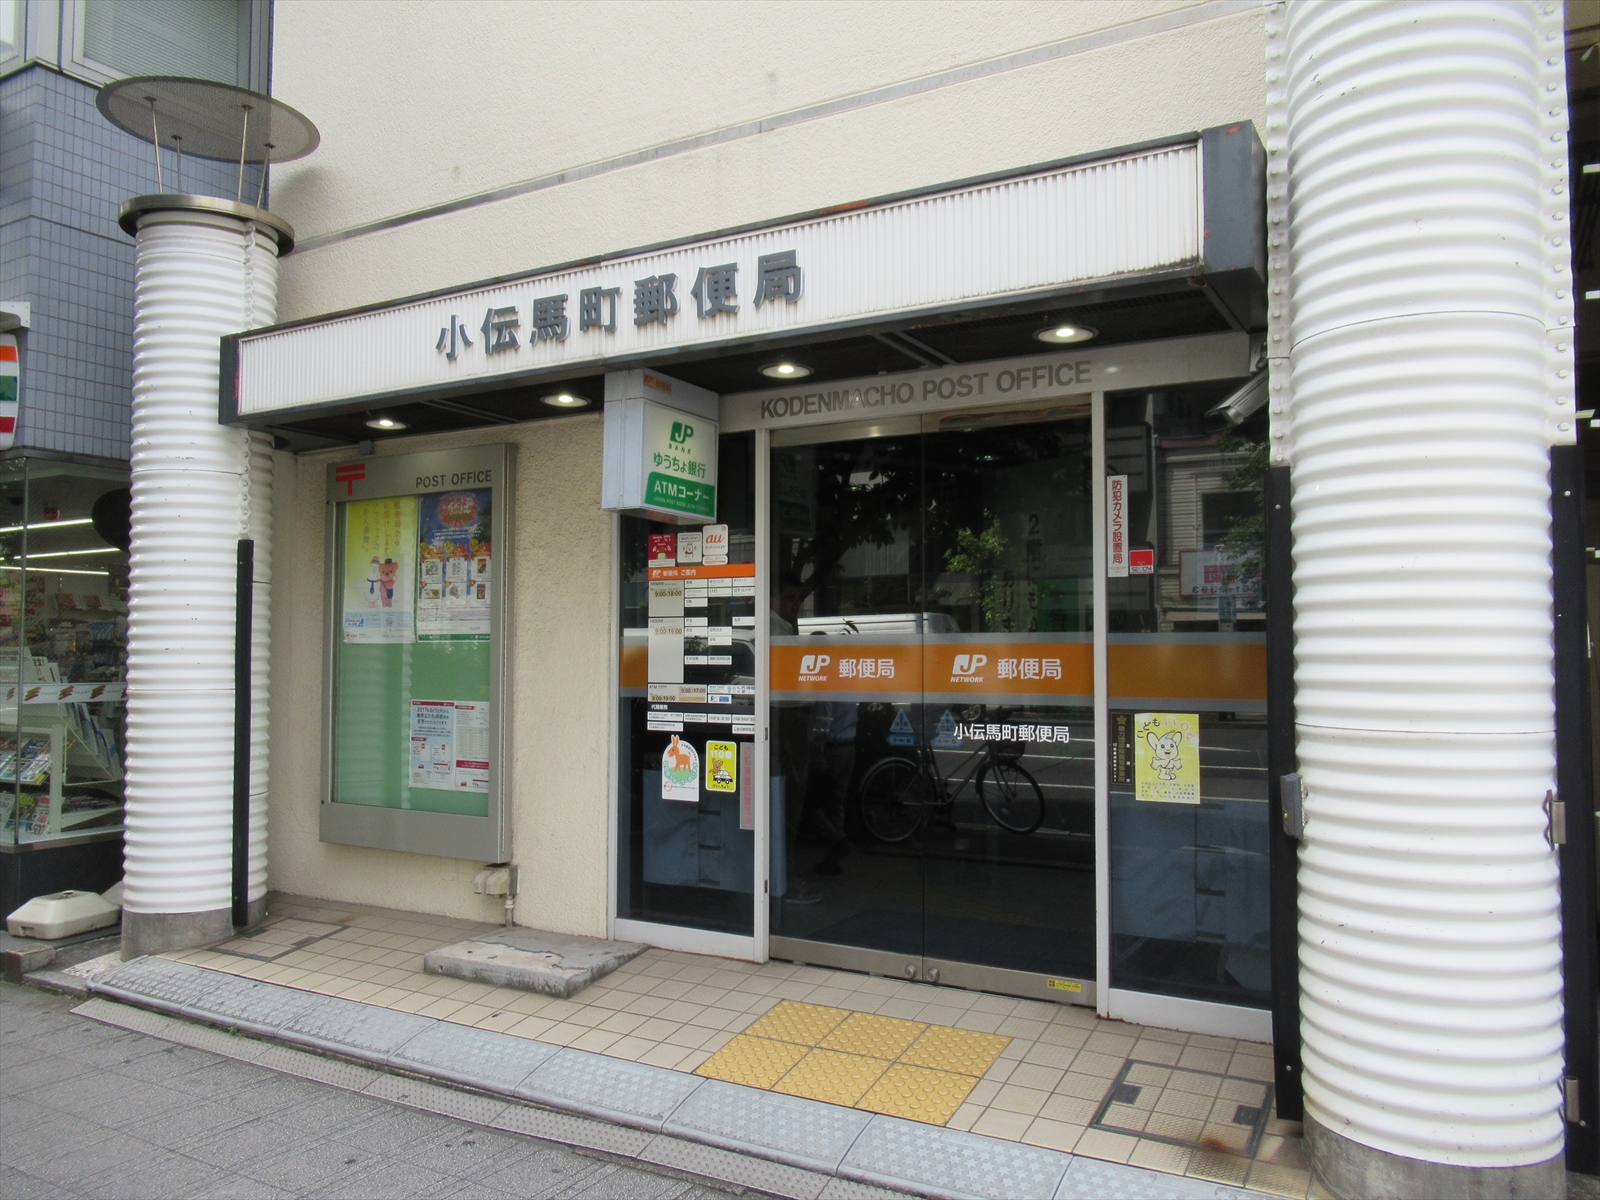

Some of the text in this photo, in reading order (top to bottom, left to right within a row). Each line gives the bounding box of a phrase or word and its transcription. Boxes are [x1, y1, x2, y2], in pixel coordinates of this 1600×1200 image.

[435, 249, 804, 360] 小伝馬町郵便局
[760, 360, 1092, 419] KODENMACHO POST OFFICE
[670, 421, 694, 444] JP
[668, 443, 692, 454] BANK
[653, 452, 706, 479] ゆうちょ銀行
[415, 470, 493, 488] POST OFFICE
[653, 480, 710, 501] ATMコーナー
[1111, 479, 1123, 564] 防犯カメラ設置局
[705, 534, 725, 544] au
[800, 655, 831, 674] JP
[838, 658, 895, 679] 郵便局
[952, 654, 987, 675] JP
[996, 658, 1062, 680] 郵便局
[953, 723, 1070, 744] 小伝馬町郵便局
